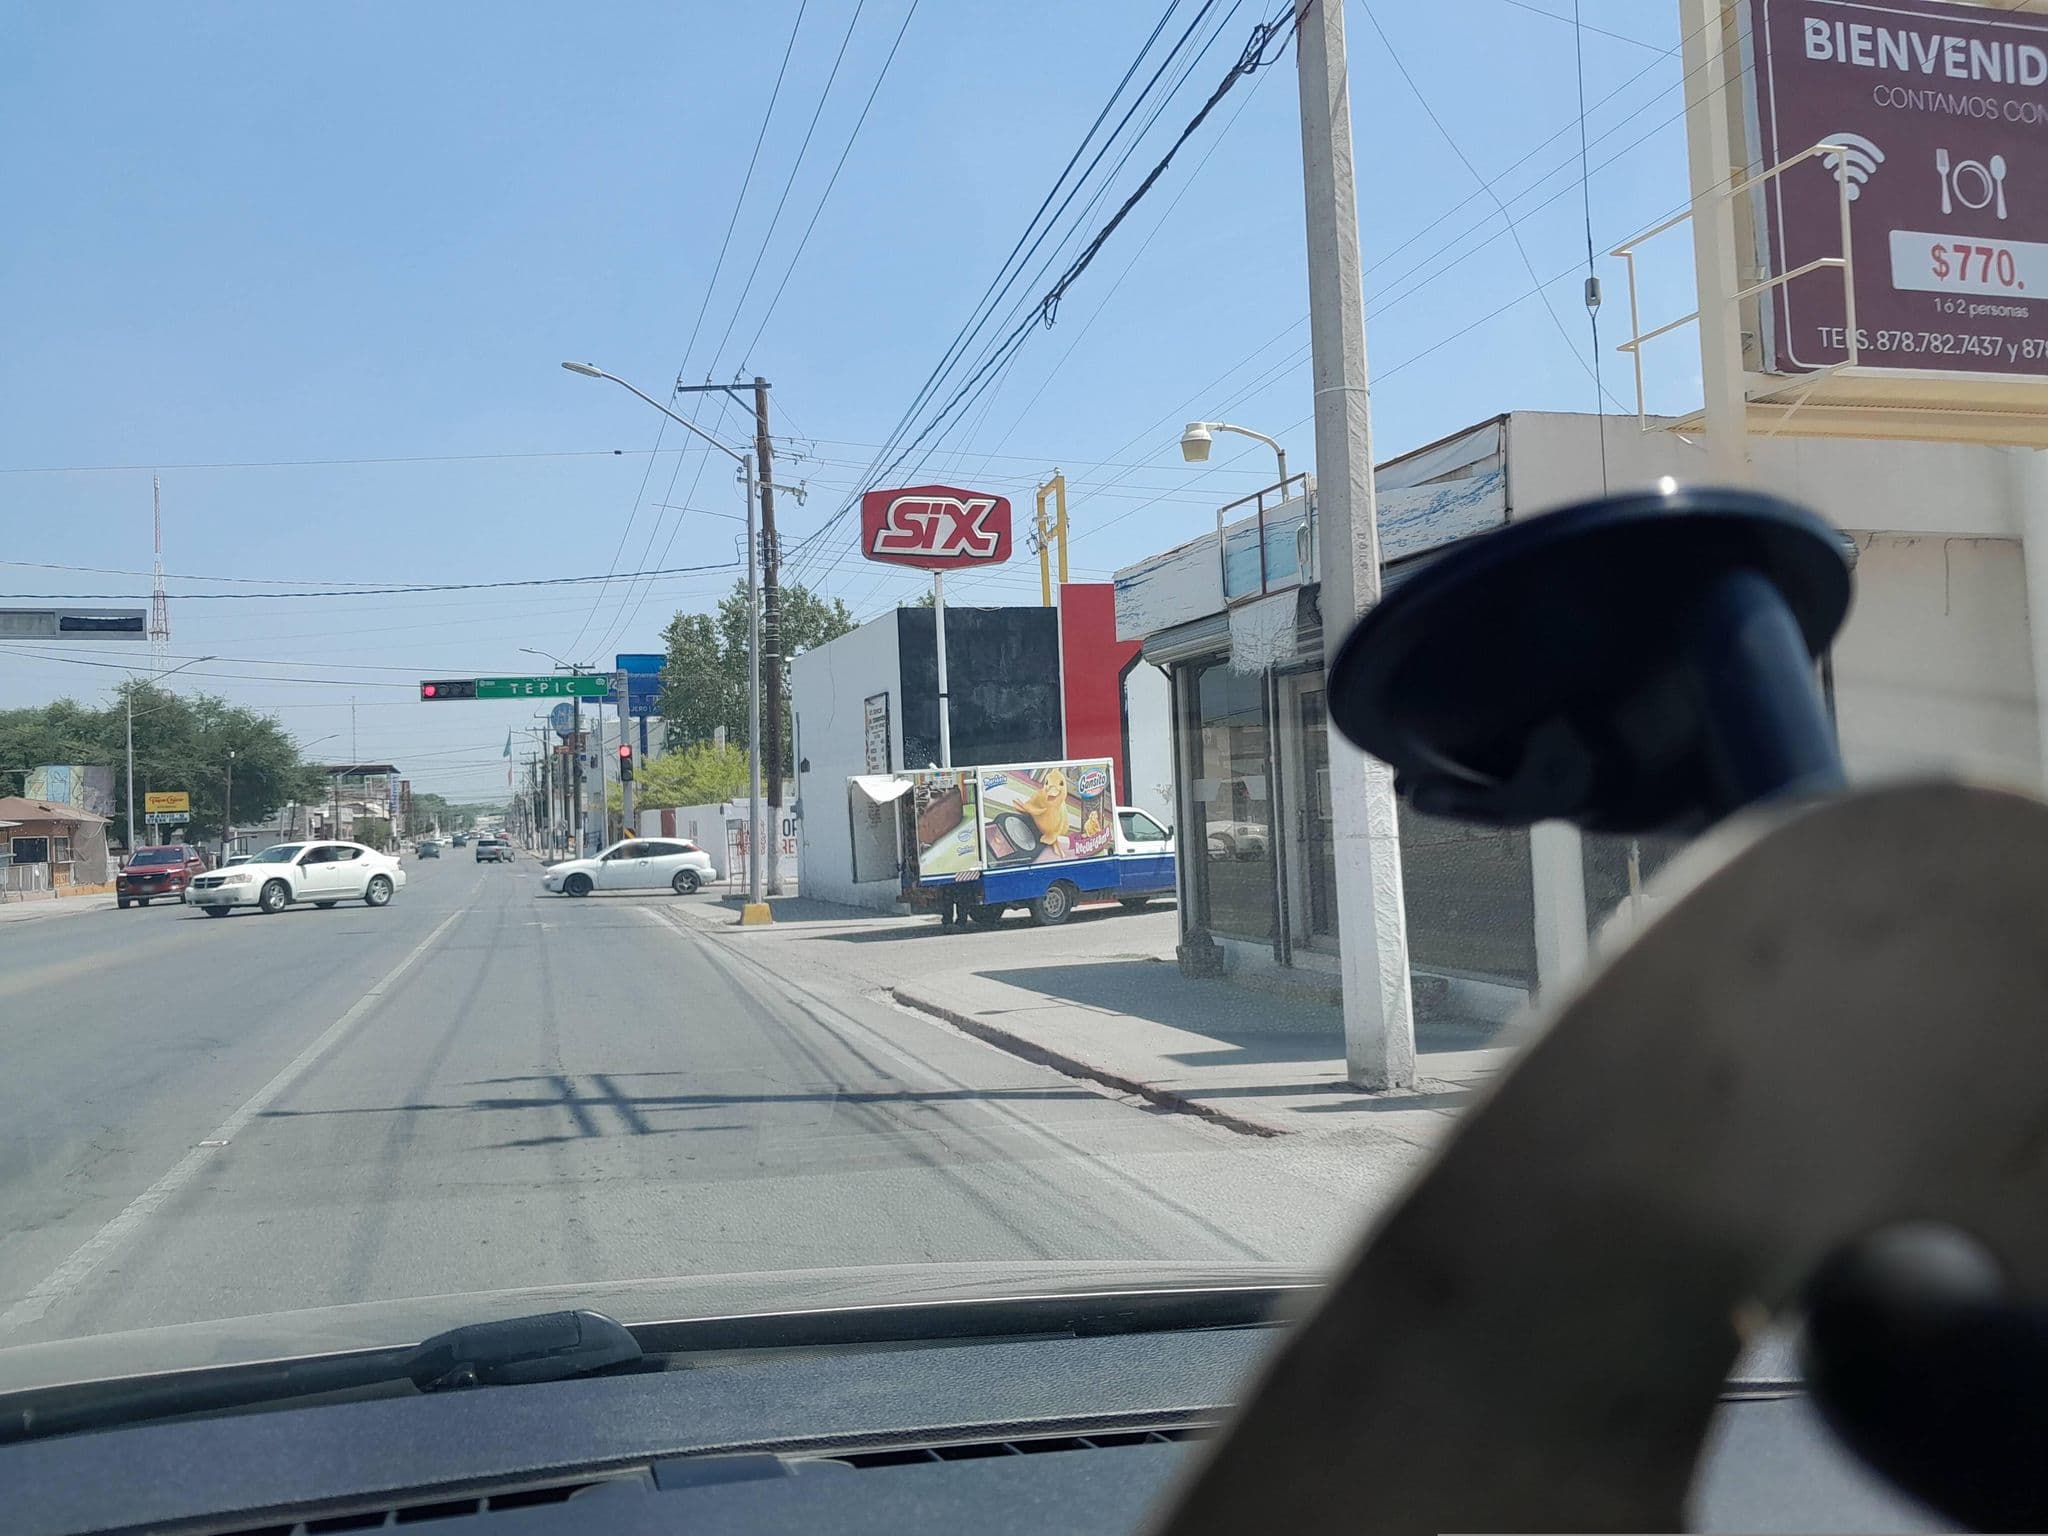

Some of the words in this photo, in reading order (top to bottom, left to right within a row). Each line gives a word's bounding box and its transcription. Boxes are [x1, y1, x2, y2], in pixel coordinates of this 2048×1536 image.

[1804, 17, 2048, 87] BIENVENID
[1873, 85, 1999, 120] CONTAMOS
[1931, 243, 2025, 290] $770.
[1934, 297, 1942, 313] 1
[1957, 298, 1967, 315] 2
[1969, 303, 2030, 318] personas
[2006, 343, 2019, 364] y
[2022, 338, 2048, 359] 87
[509, 681, 575, 695] TEPIC
[1079, 769, 1106, 793] Gansito
